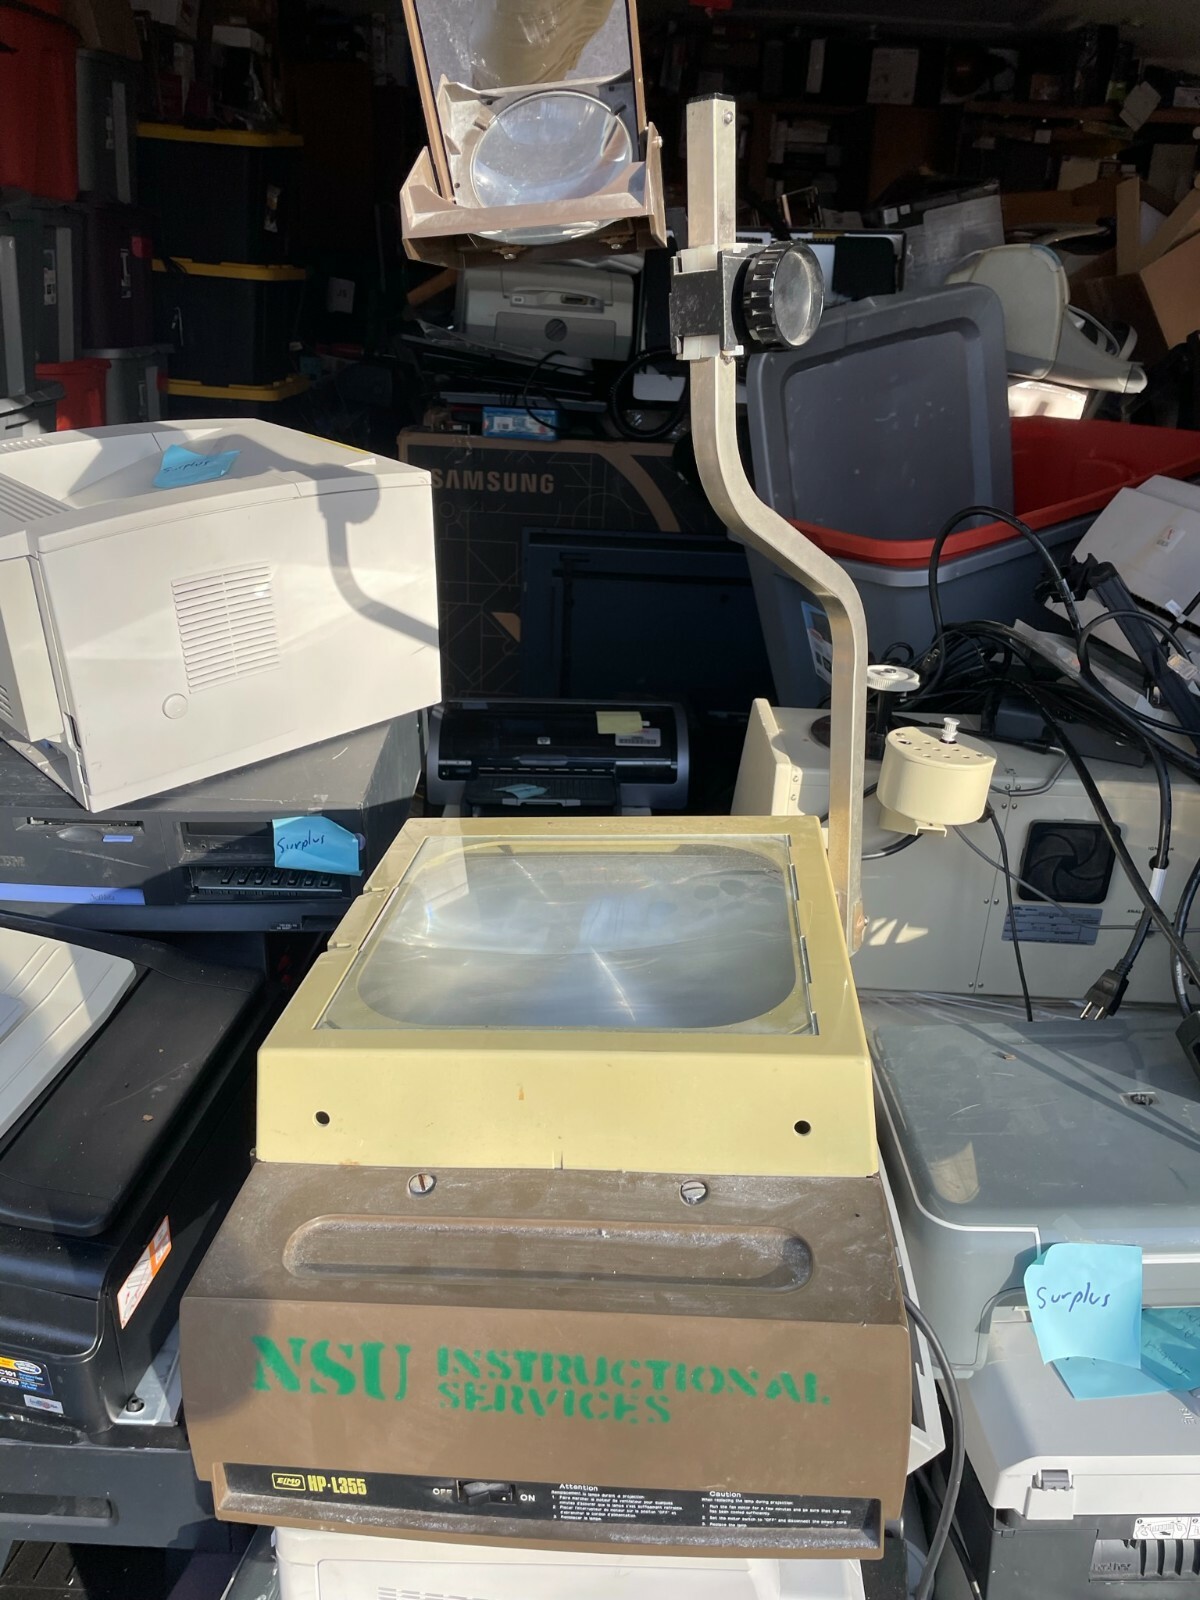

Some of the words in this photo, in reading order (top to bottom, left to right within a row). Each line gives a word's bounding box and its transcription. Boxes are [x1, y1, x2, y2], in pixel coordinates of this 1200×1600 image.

[431, 468, 555, 494] SAMSUNG
[276, 829, 325, 854] Surplus
[1036, 1281, 1111, 1313] Surplus
[250, 1334, 412, 1401] NSU
[436, 1345, 832, 1406] INSTRUCTIONAL
[436, 1380, 672, 1426] SERVICES
[276, 1477, 301, 1487] ELMO
[559, 1483, 599, 1492] Attention
[432, 1487, 453, 1496] OFF
[519, 1493, 536, 1502] ON
[709, 1490, 742, 1498] Caution
